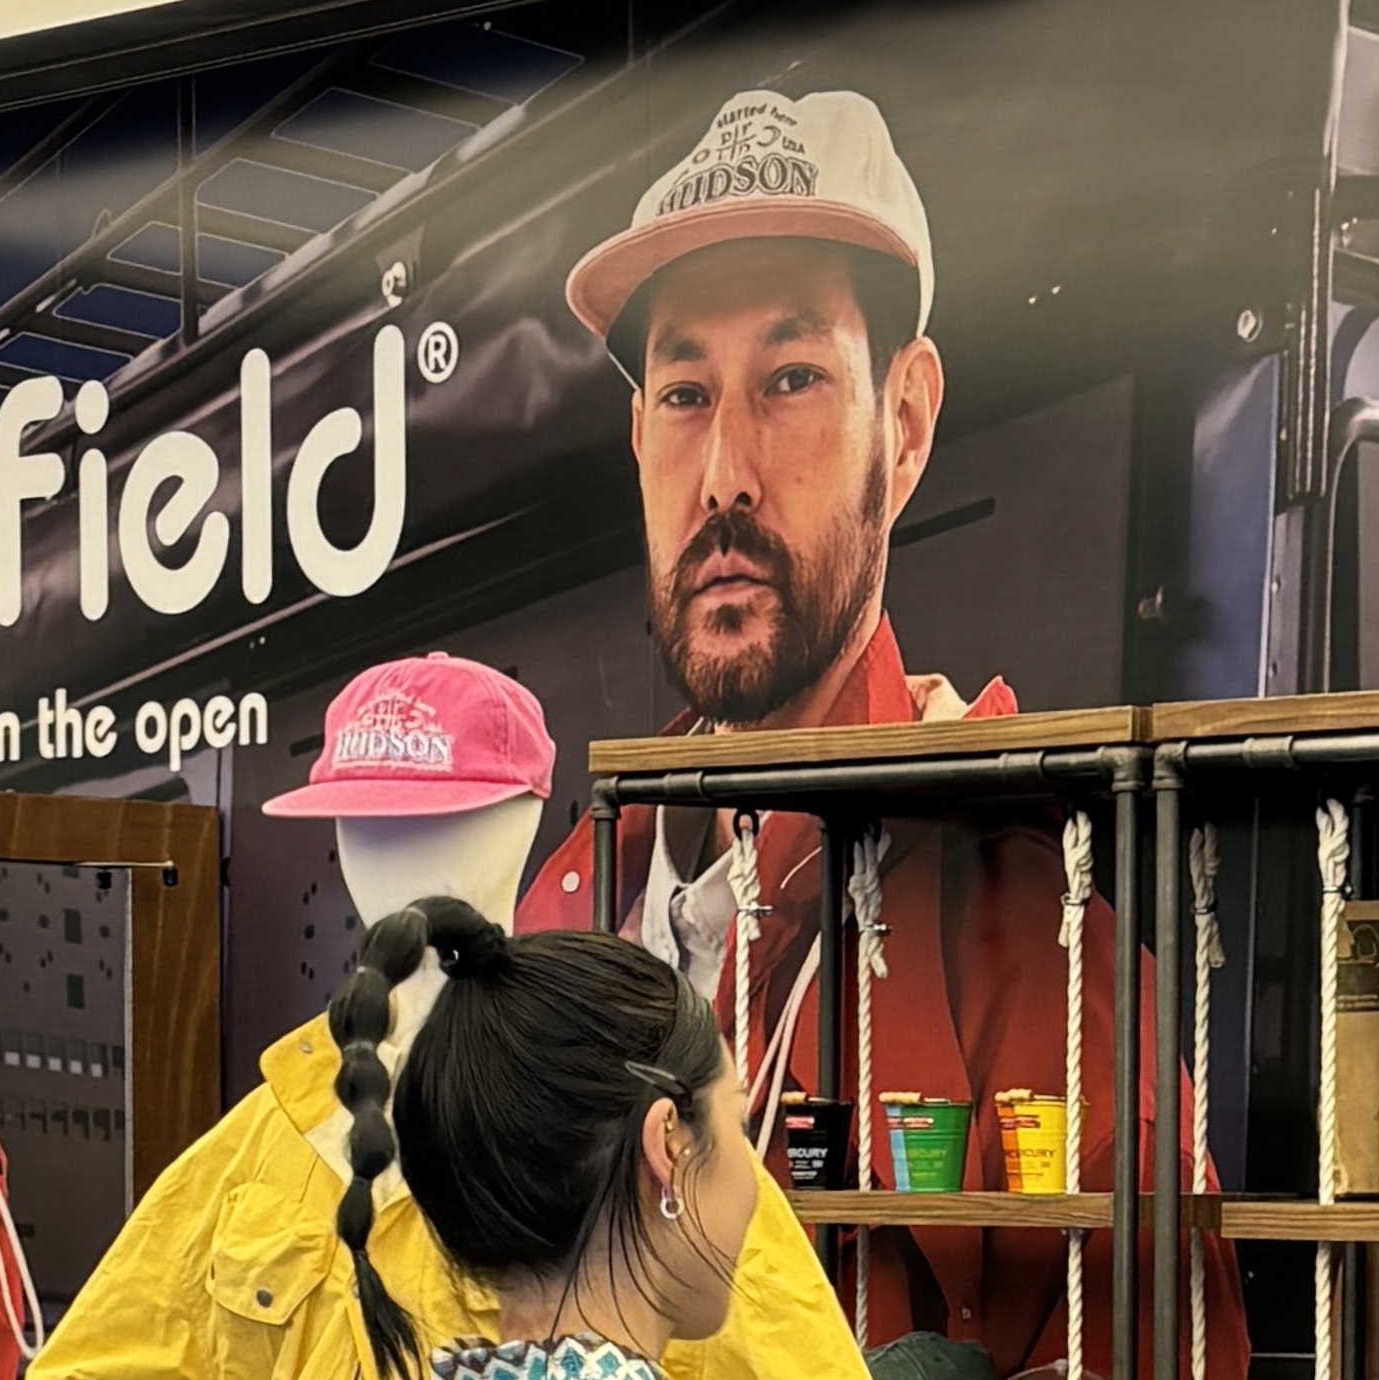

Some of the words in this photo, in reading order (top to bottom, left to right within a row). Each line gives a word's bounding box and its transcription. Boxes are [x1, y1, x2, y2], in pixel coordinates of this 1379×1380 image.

[656, 152, 818, 217] HUDSON
[38, 688, 117, 760] the
[136, 692, 268, 772] open
